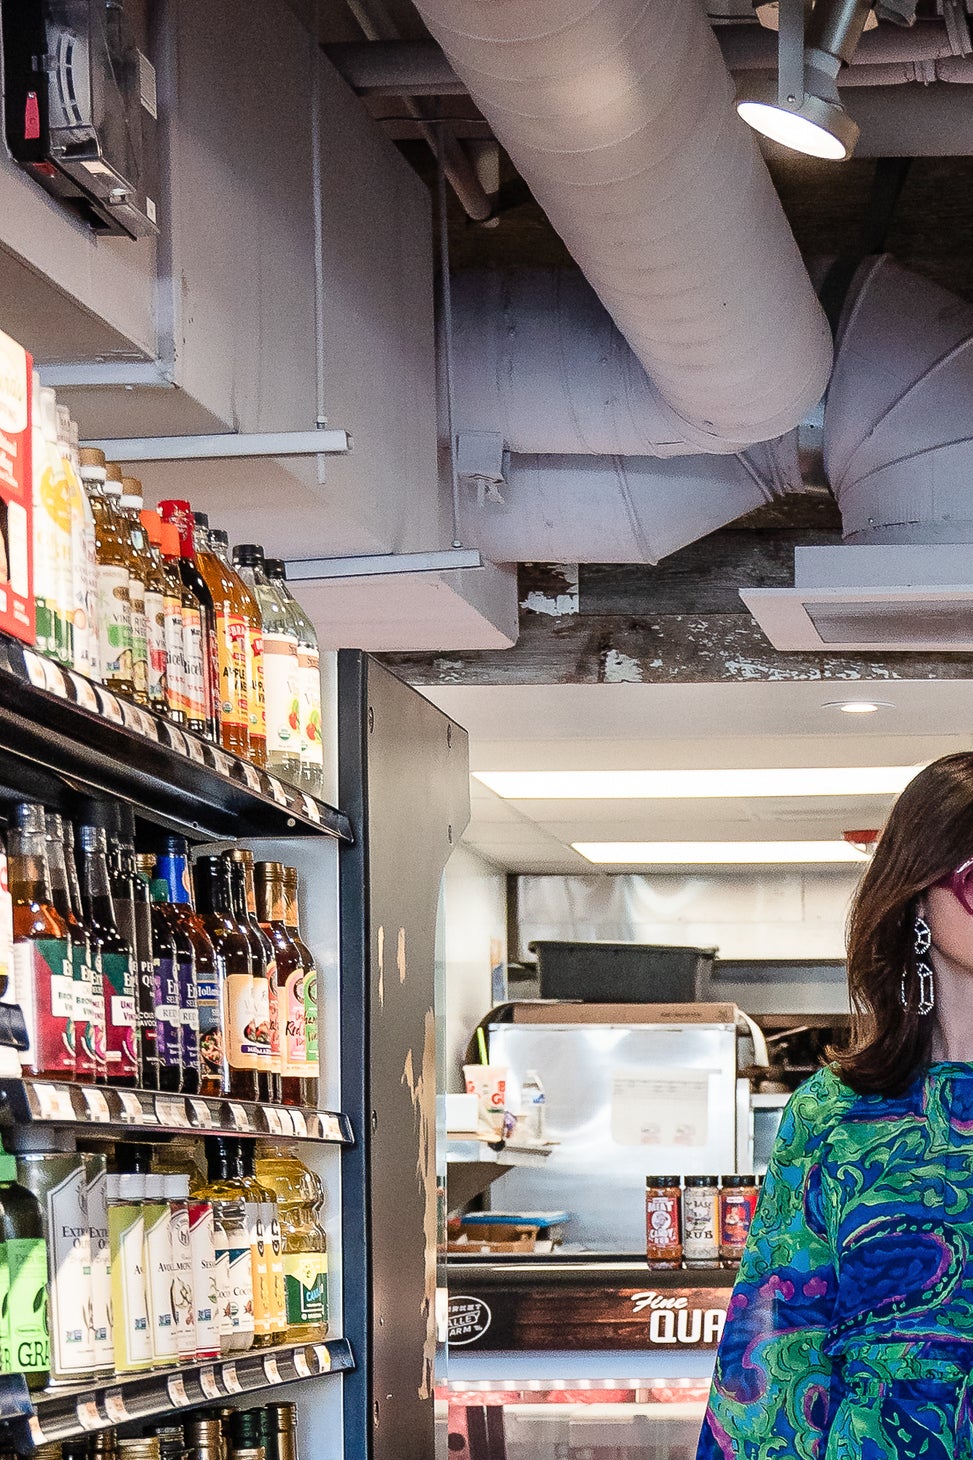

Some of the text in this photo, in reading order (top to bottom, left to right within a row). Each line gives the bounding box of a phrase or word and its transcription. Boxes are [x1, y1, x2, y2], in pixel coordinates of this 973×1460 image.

[630, 1291, 689, 1313] Fine
[448, 1313, 479, 1327] ALLEY
[648, 1308, 728, 1344] QUA
[450, 1326, 472, 1337] ARM
